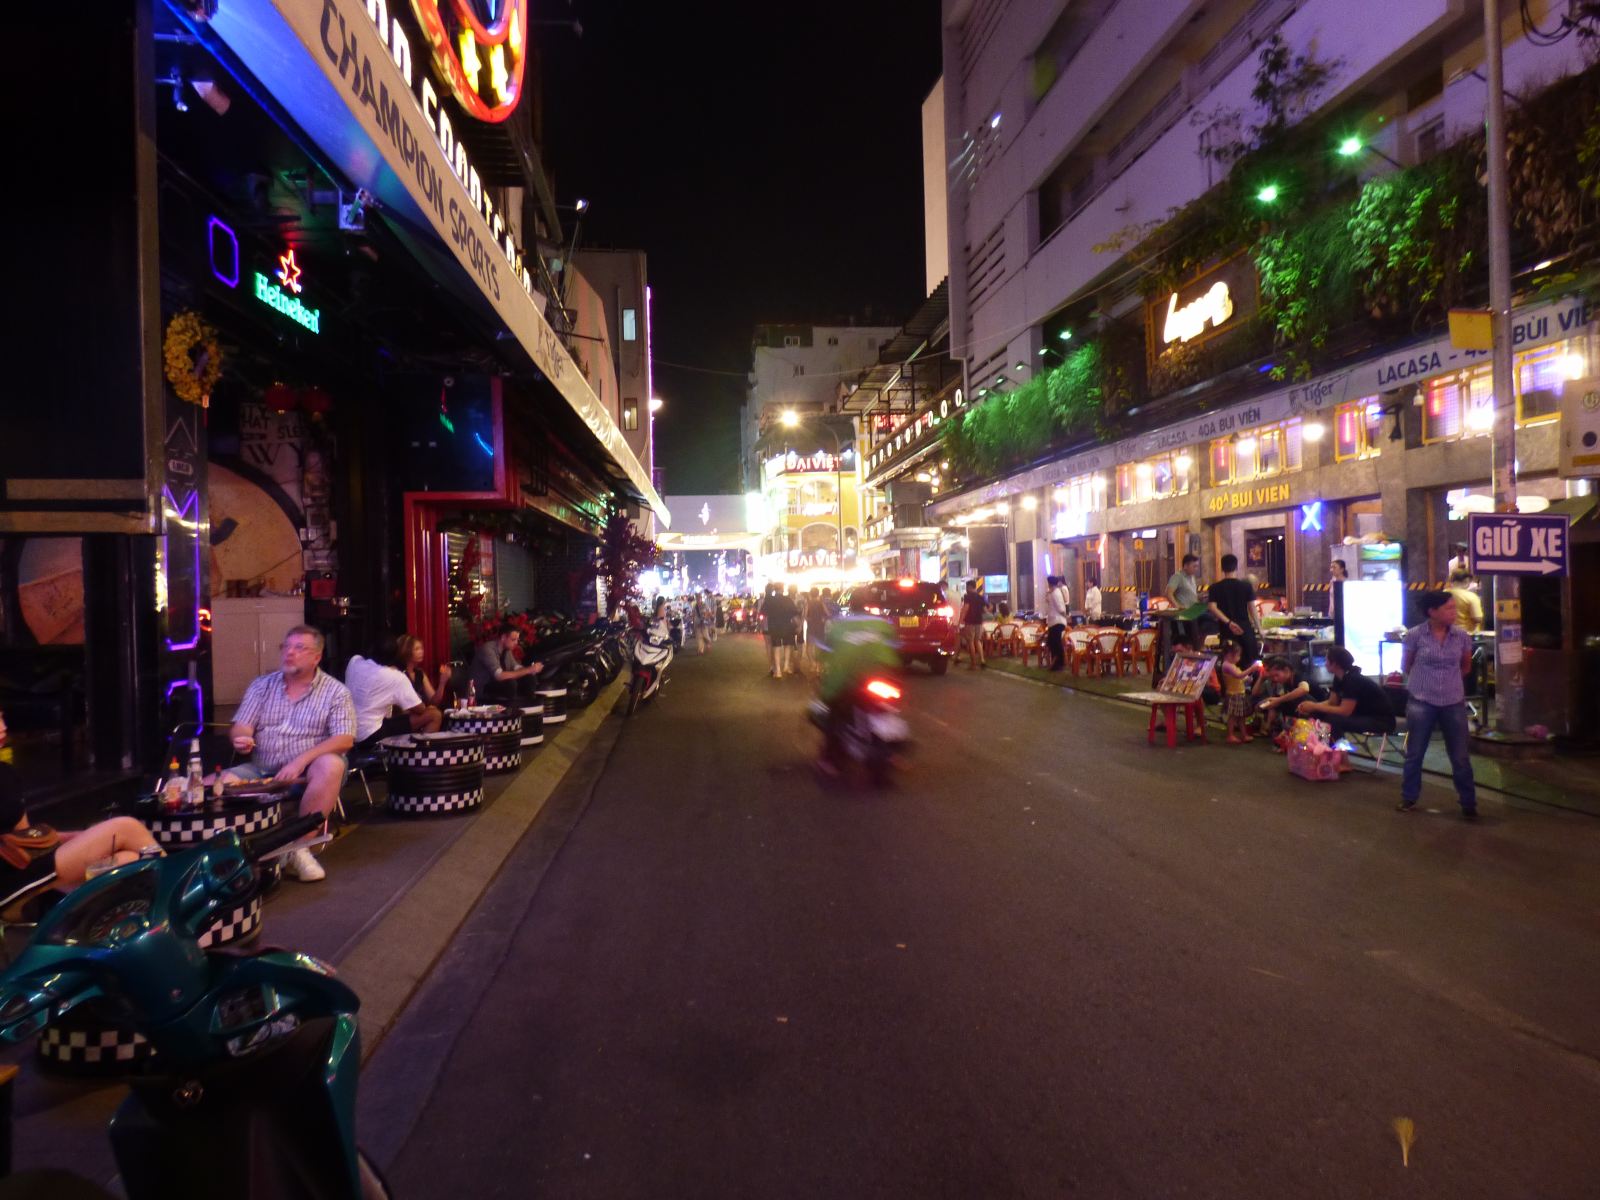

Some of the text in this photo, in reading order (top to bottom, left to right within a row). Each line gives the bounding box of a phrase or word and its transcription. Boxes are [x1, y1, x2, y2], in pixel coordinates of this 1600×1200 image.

[320, 0, 445, 224] CHAMPION
[449, 203, 501, 302] SPORTS
[255, 272, 320, 334] Heineken
[1377, 351, 1442, 386] LACASA
[1302, 381, 1334, 406] Tiger
[1231, 490, 1253, 509] BUI
[1256, 483, 1291, 505] VIEN
[1475, 519, 1562, 558] GIỮ XE
